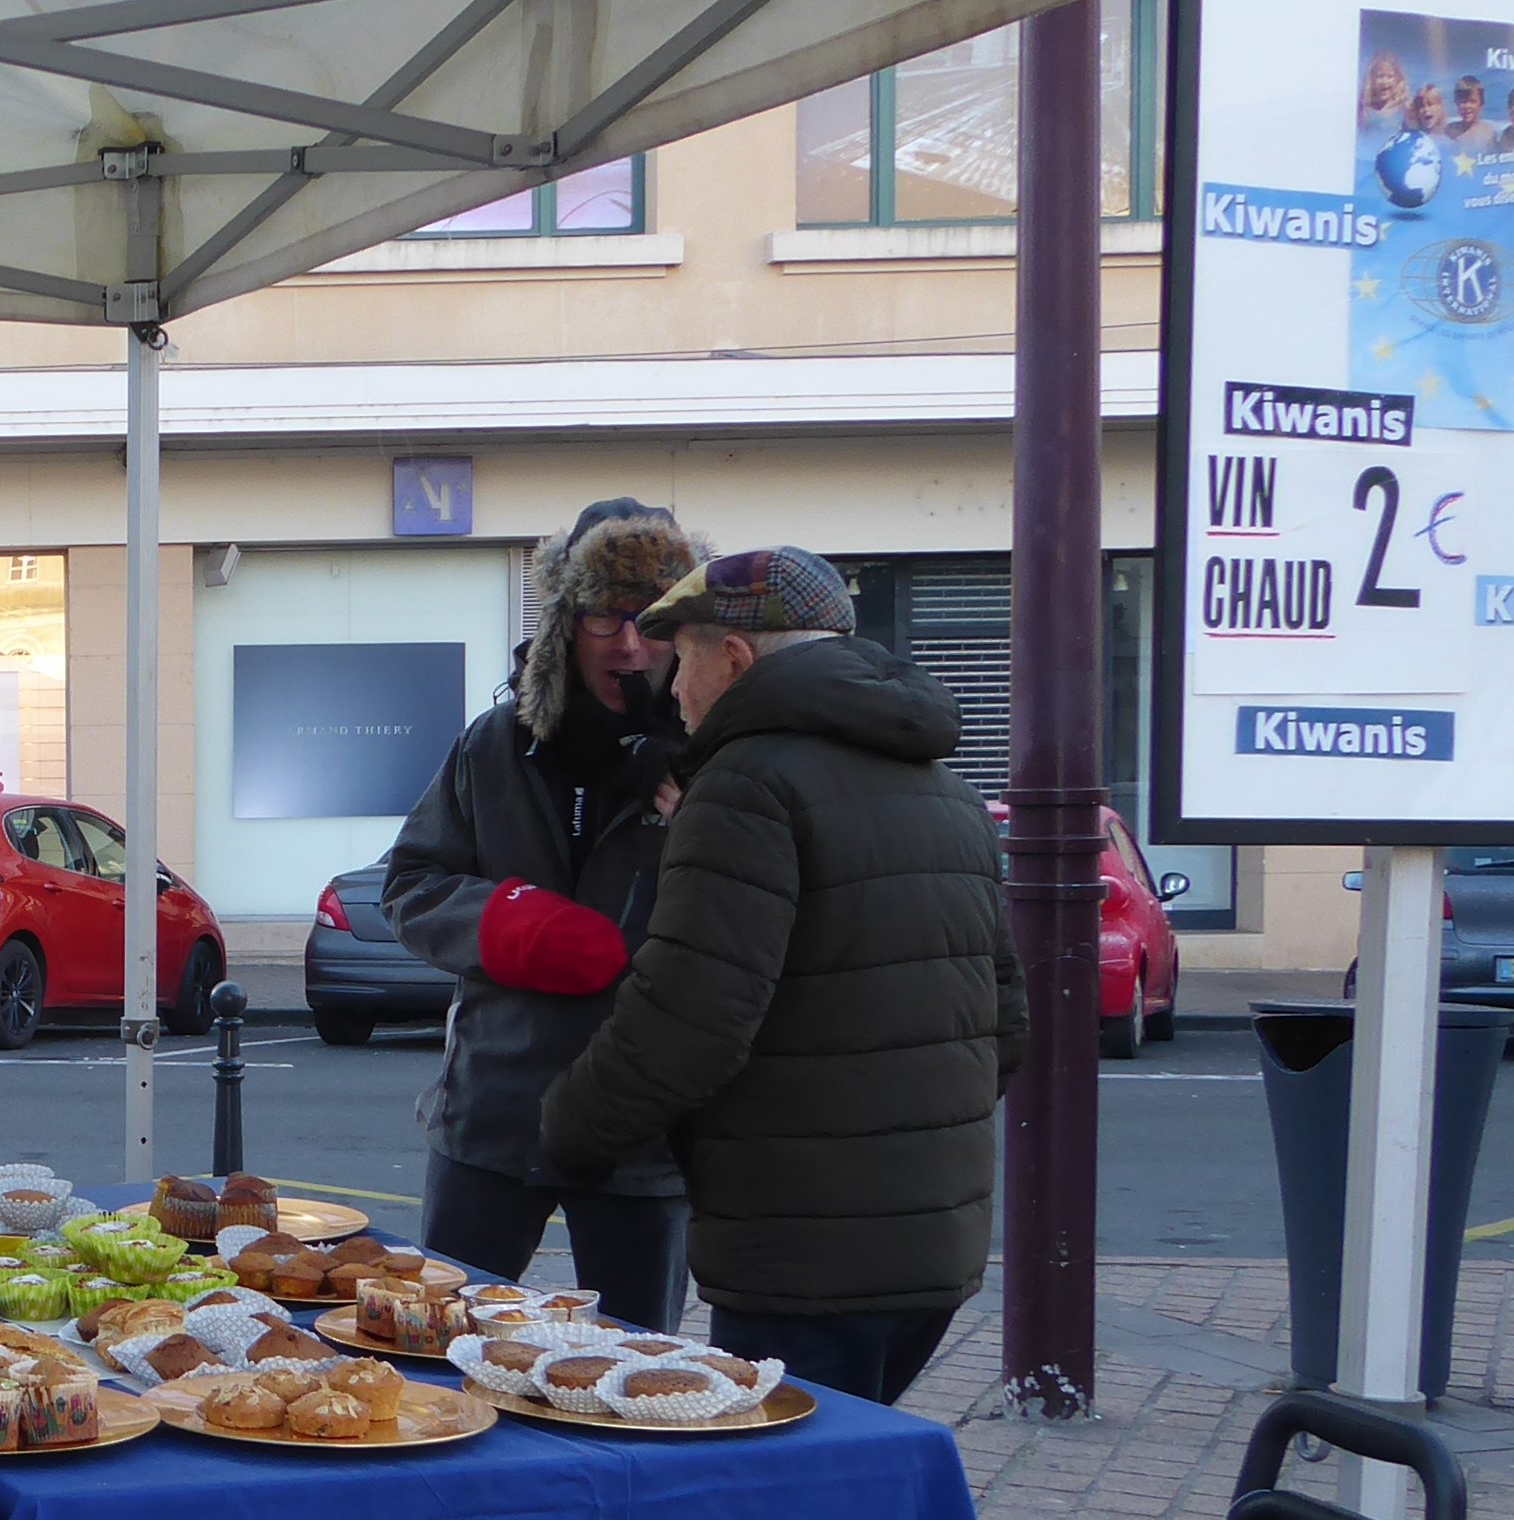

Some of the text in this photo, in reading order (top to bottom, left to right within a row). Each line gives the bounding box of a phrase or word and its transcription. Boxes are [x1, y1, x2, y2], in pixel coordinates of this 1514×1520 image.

[1205, 192, 1379, 246] Kiwanis
[1457, 257, 1484, 304] K
[1231, 389, 1407, 441] Kiwanis
[1207, 454, 1278, 528] VIN
[1203, 555, 1333, 630] CHAUD
[288, 725, 413, 735] RMAND THIERY
[1254, 710, 1427, 757] Kiwanis
[572, 796, 583, 836] Lafuma
